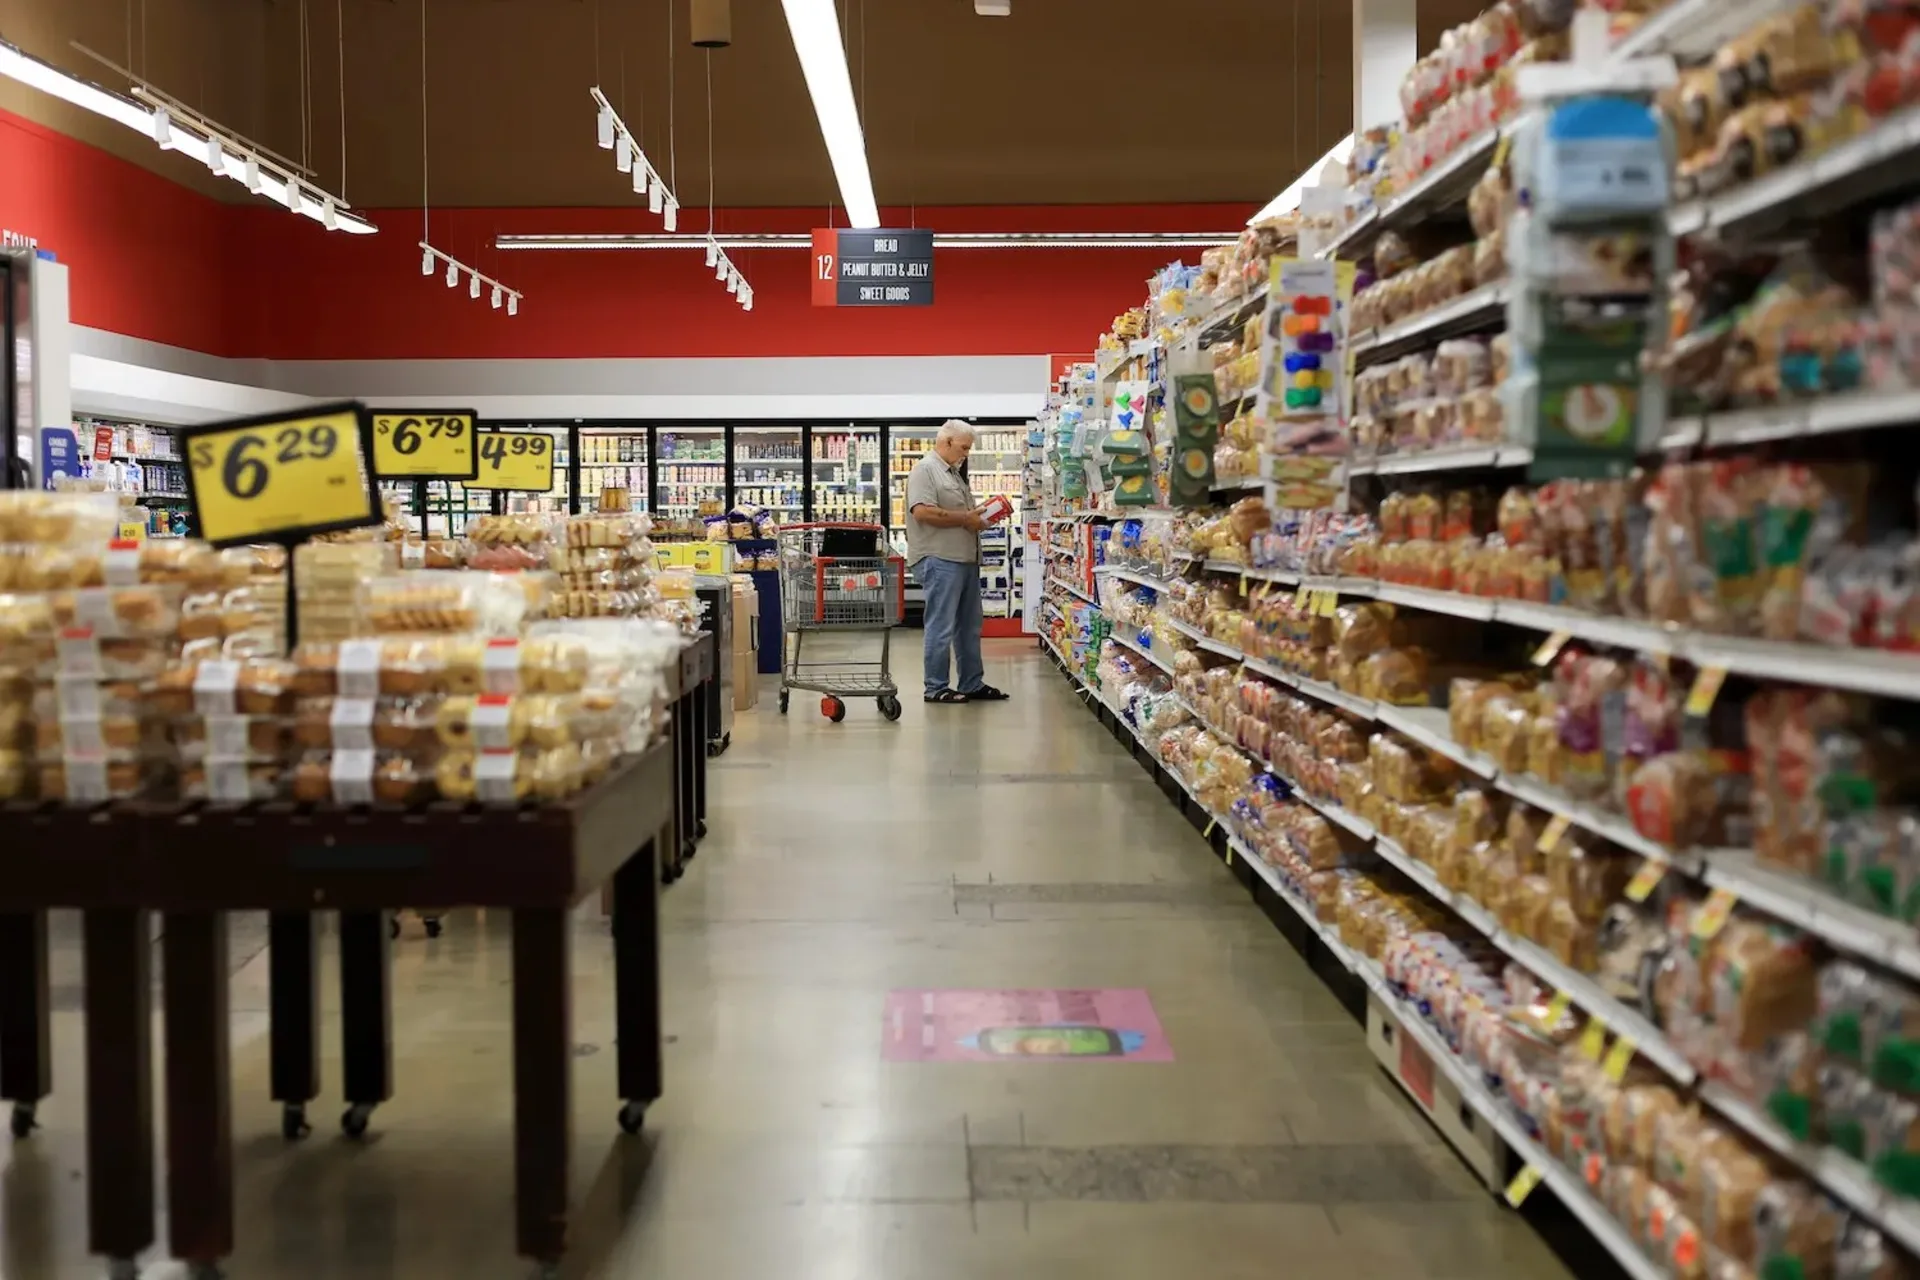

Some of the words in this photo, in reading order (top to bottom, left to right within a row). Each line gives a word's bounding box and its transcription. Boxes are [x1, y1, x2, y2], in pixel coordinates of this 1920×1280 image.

[873, 239, 898, 252] BREAD
[817, 254, 833, 280] 12
[842, 263, 870, 276] PEANUT
[871, 263, 897, 276] BUTTER
[898, 263, 905, 276] &
[907, 263, 928, 276] JELLY
[859, 287, 884, 300] SWEET
[885, 287, 910, 300] GOODS
